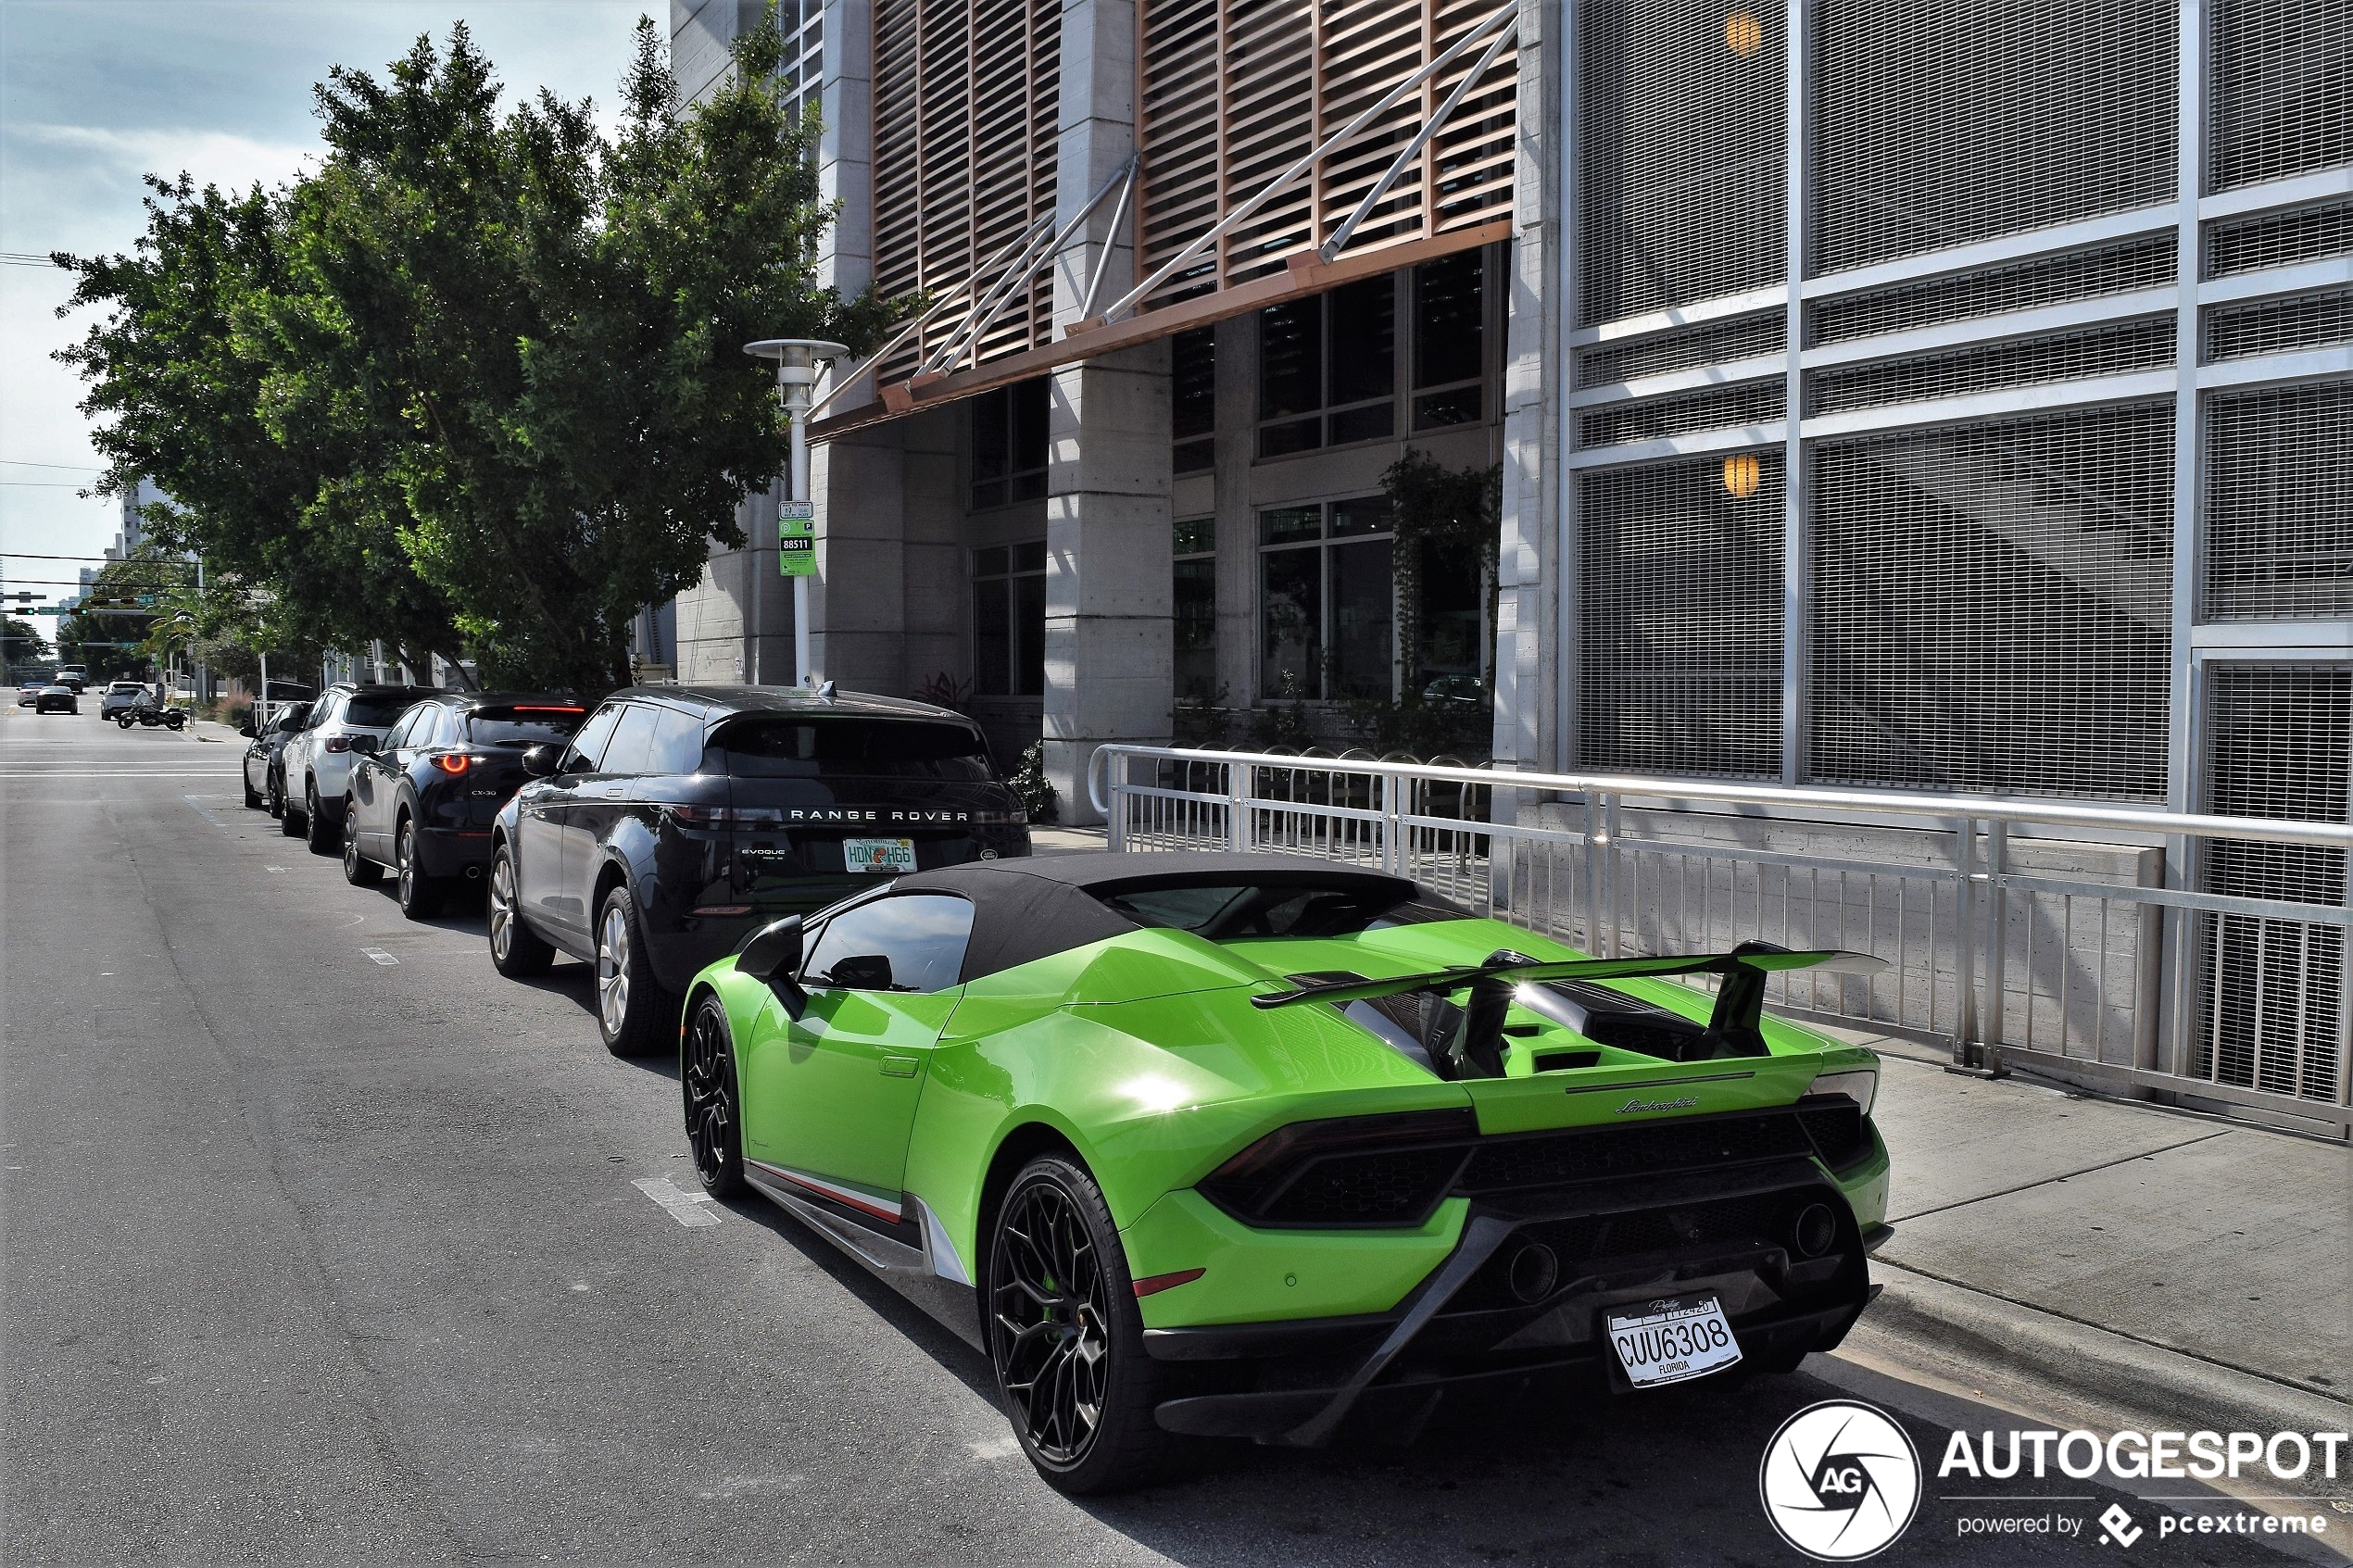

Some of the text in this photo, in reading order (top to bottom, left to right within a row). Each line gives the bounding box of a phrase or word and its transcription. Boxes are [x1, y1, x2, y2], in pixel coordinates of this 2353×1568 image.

[783, 539, 808, 549] 88511
[790, 809, 968, 822] RANGE ROVER
[848, 846, 911, 863] HDN H66
[1615, 1097, 1699, 1114] Lamborghini
[1617, 1319, 1729, 1368] CUU6308
[1658, 1360, 1691, 1375] FLORIDA
